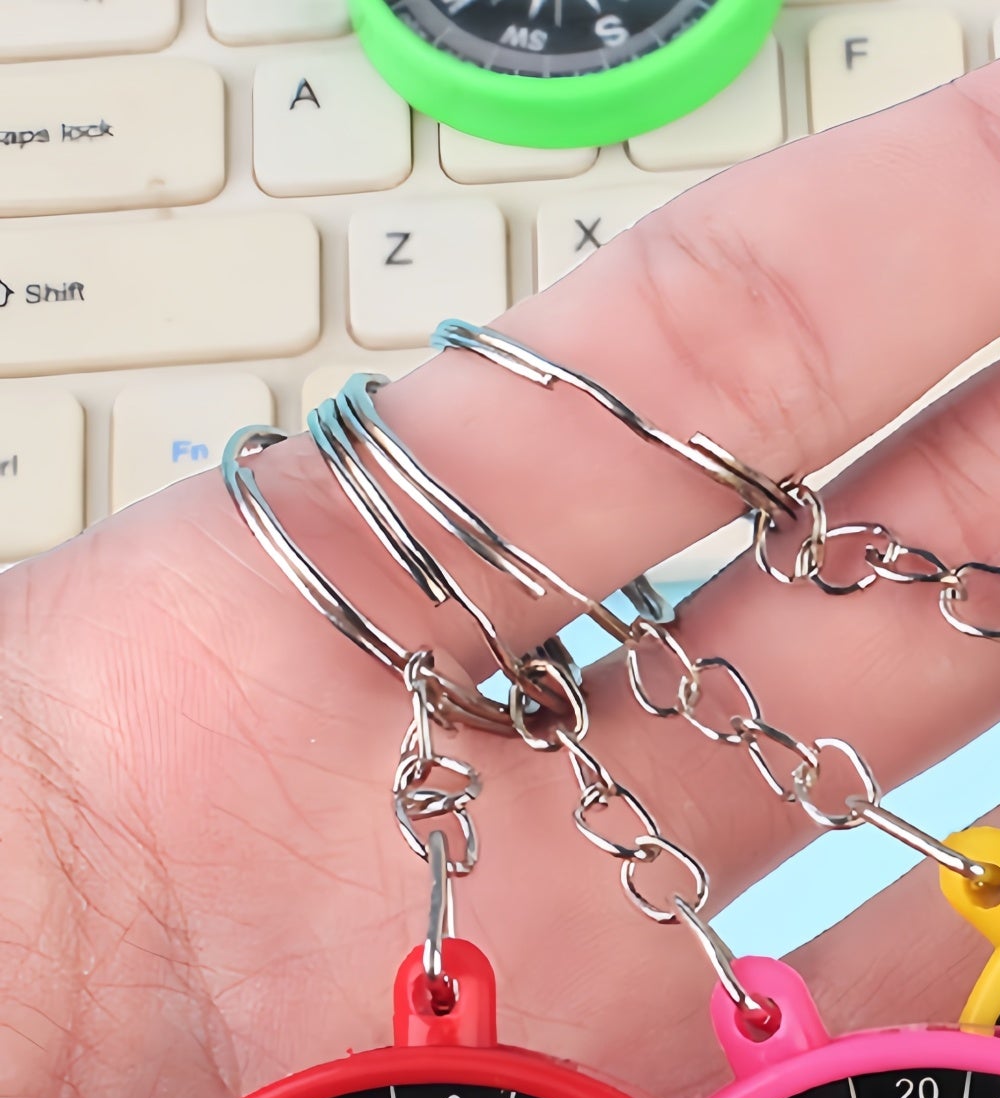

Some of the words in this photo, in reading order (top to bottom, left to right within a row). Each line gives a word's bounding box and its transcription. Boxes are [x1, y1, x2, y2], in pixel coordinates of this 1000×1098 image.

[501, 25, 548, 52] SW
[595, 14, 629, 47] S
[845, 37, 869, 71] F
[289, 78, 321, 110] A
[385, 231, 414, 266] Z
[575, 218, 602, 251] X
[25, 280, 85, 304] Shift
[172, 440, 209, 463] Fn
